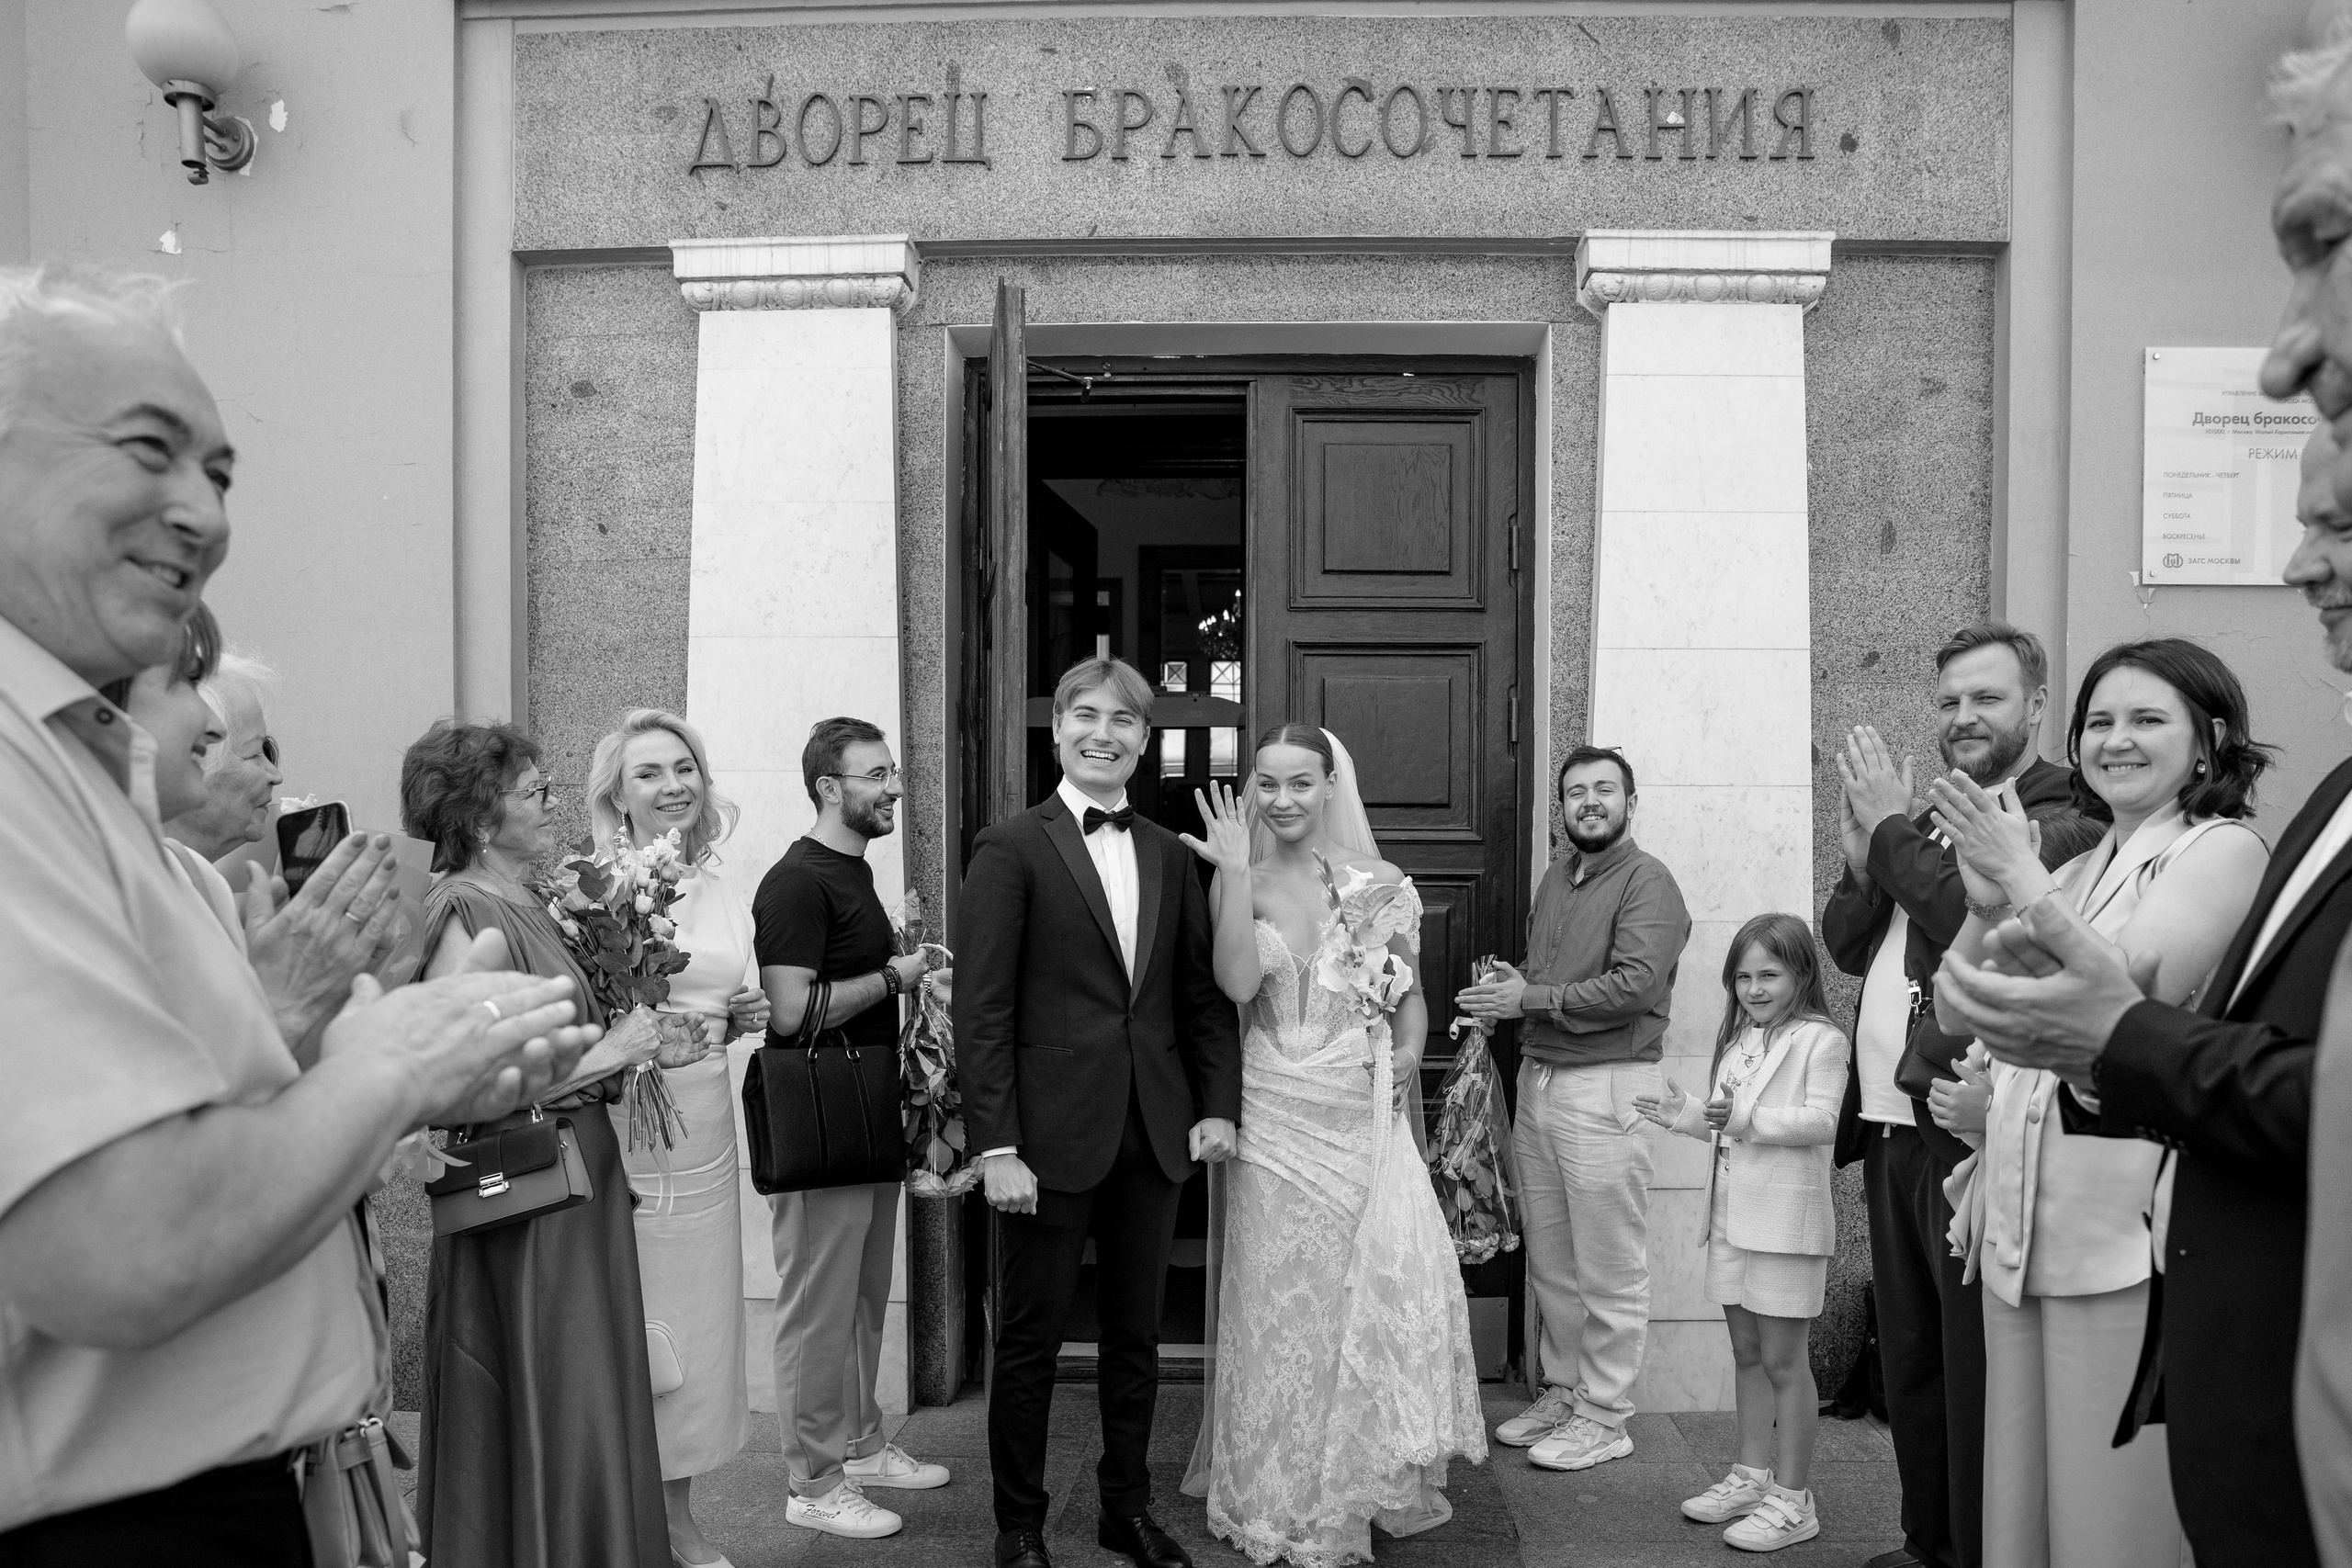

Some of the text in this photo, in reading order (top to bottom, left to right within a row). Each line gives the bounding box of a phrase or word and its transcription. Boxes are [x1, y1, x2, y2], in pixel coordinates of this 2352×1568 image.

[689, 83, 1815, 175] ДВОРЕЦ БРАКОСОЧЕТАНИЯ
[2192, 412, 2250, 427] Дворец
[2248, 448, 2298, 459] РЕЖИМ
